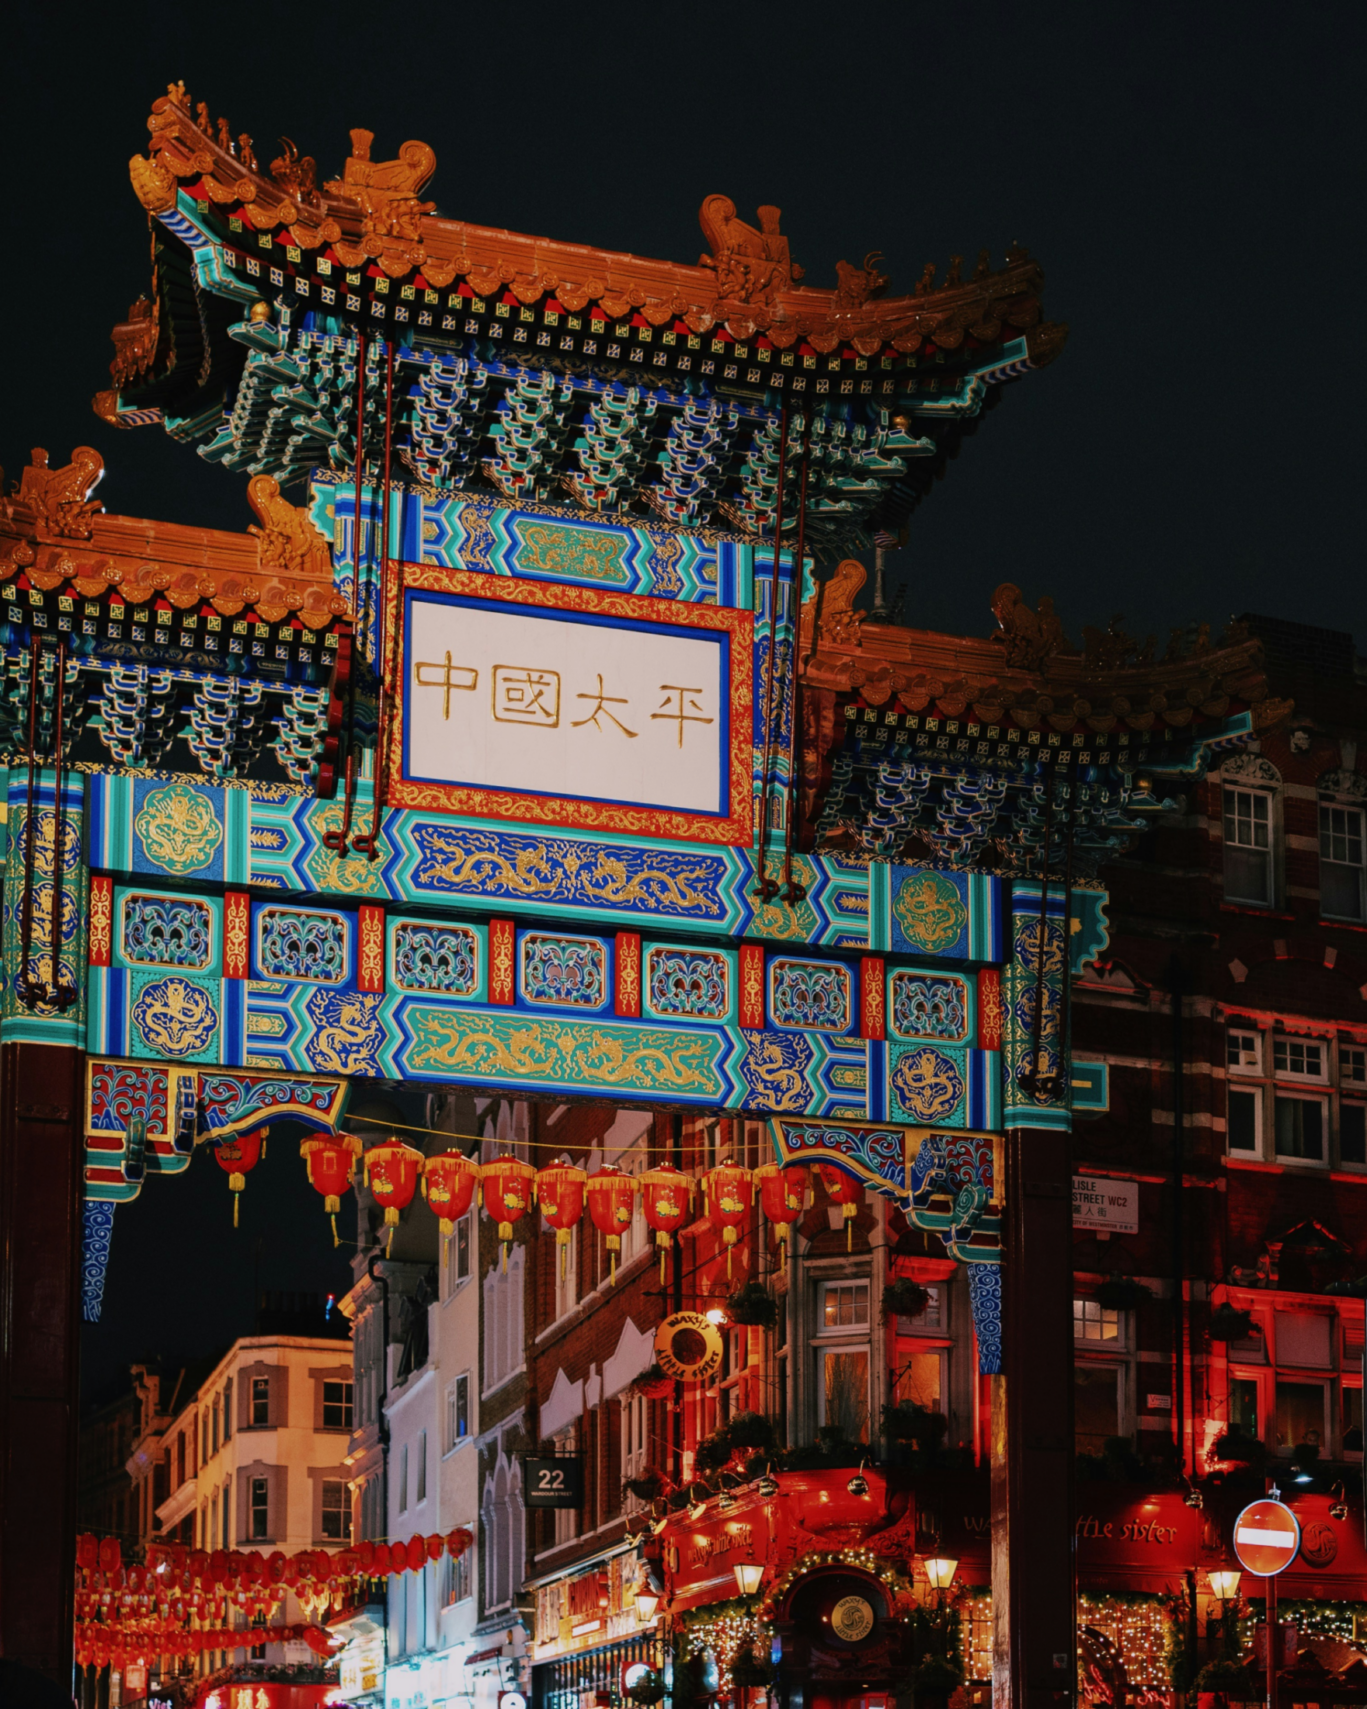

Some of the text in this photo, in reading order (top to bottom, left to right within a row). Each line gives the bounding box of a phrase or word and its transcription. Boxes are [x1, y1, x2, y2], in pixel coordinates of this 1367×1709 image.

[413, 650, 715, 749] 中國太平
[1072, 1180, 1096, 1192] LISLE
[1072, 1192, 1128, 1208] STREET WC2
[538, 1469, 565, 1489] 22
[1120, 1518, 1177, 1542] sister
